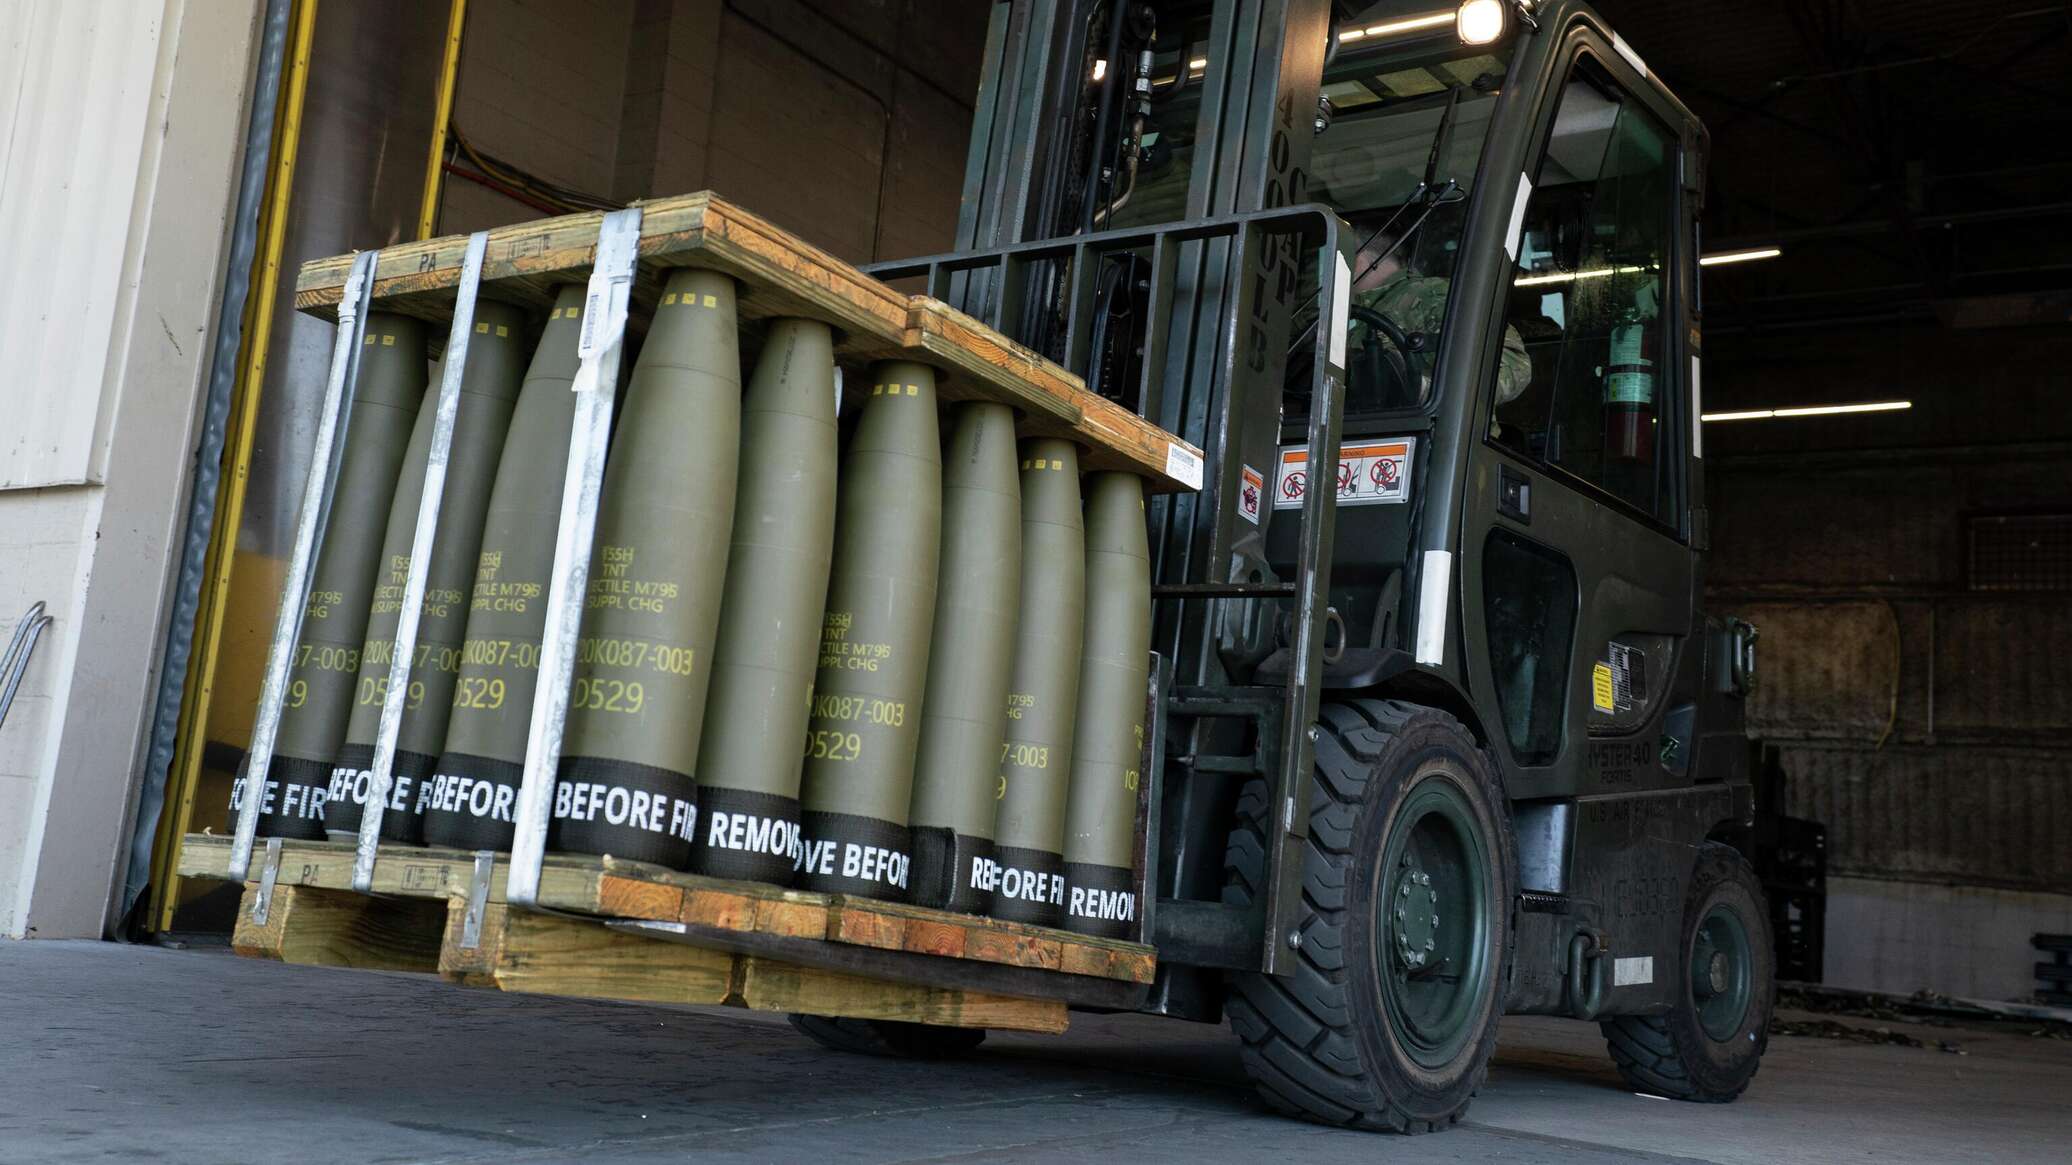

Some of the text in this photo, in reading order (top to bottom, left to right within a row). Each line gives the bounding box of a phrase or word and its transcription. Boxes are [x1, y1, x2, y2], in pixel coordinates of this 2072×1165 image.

[603, 564, 628, 577] TNT
[634, 581, 679, 599] M795
[494, 598, 527, 613] CHG
[628, 598, 664, 613] CHG
[852, 643, 891, 658] M795
[847, 657, 878, 672] CHG
[573, 678, 645, 714] D529
[554, 781, 668, 833] BEFORE
